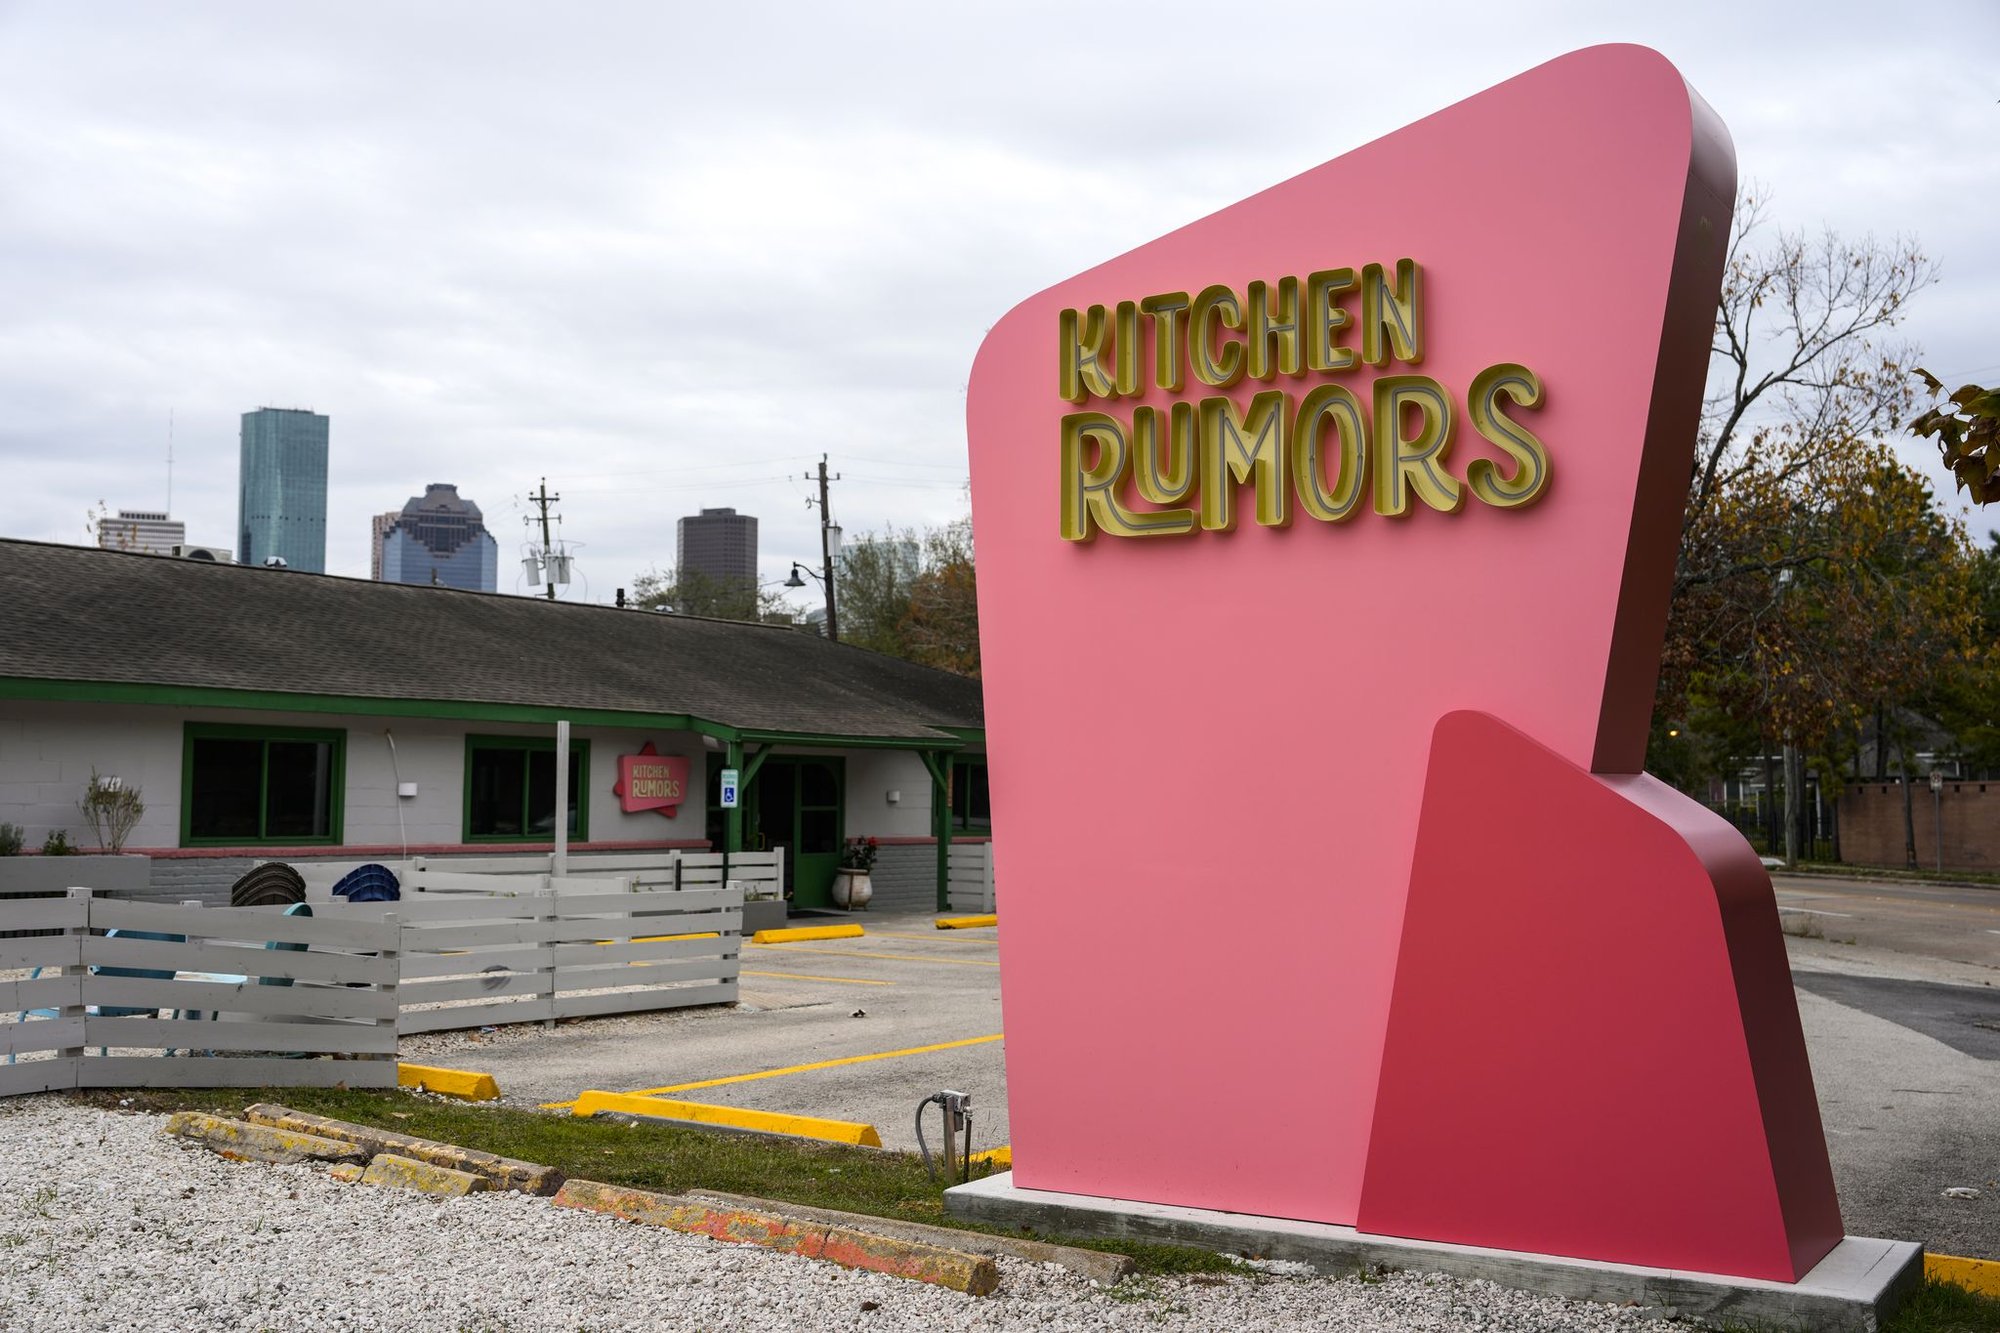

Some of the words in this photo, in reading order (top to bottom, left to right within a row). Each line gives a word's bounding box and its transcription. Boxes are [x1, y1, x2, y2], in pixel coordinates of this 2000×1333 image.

[1059, 258, 1424, 402] KITCHEN
[1059, 363, 1552, 542] RUMORS
[632, 764, 670, 779] KITCHEN
[632, 780, 680, 798] RUMORS
